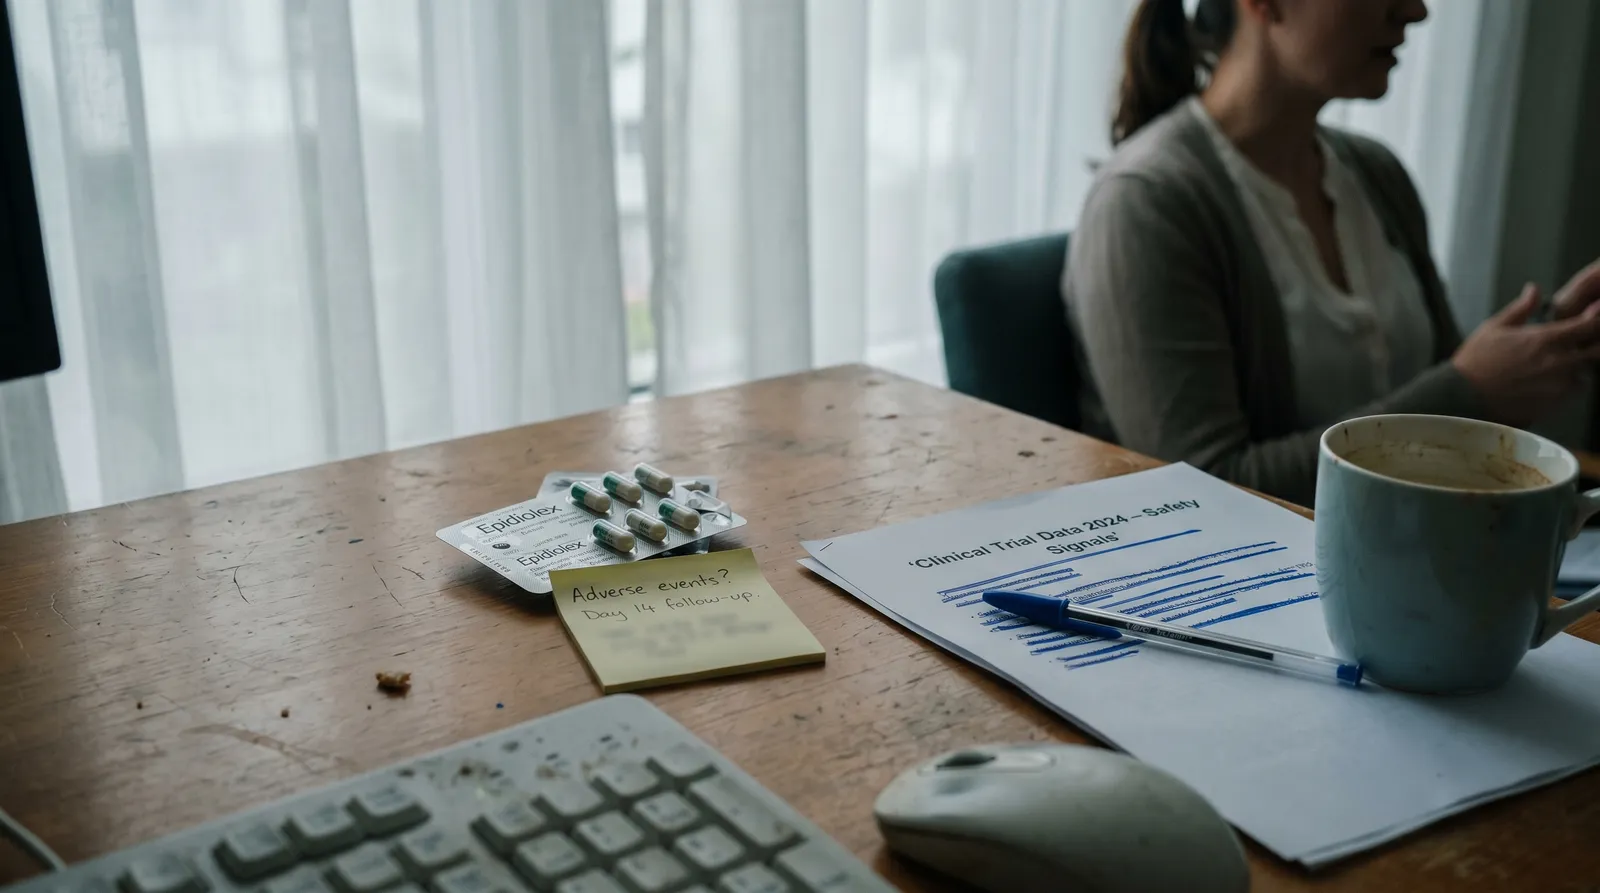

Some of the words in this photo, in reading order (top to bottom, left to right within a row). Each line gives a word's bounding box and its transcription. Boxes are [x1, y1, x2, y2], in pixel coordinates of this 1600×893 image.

[476, 505, 563, 535] Epidiolex
[990, 534, 1038, 552] Trial
[1036, 525, 1085, 542] Data
[1083, 514, 1129, 531] 2024
[1142, 500, 1200, 518] Safety
[516, 541, 587, 567] Epidiolex
[572, 586, 647, 603] Adverse
[658, 568, 732, 592] events?
[581, 608, 628, 622] Day
[634, 603, 656, 614] 14
[666, 591, 760, 611] follow-up.
